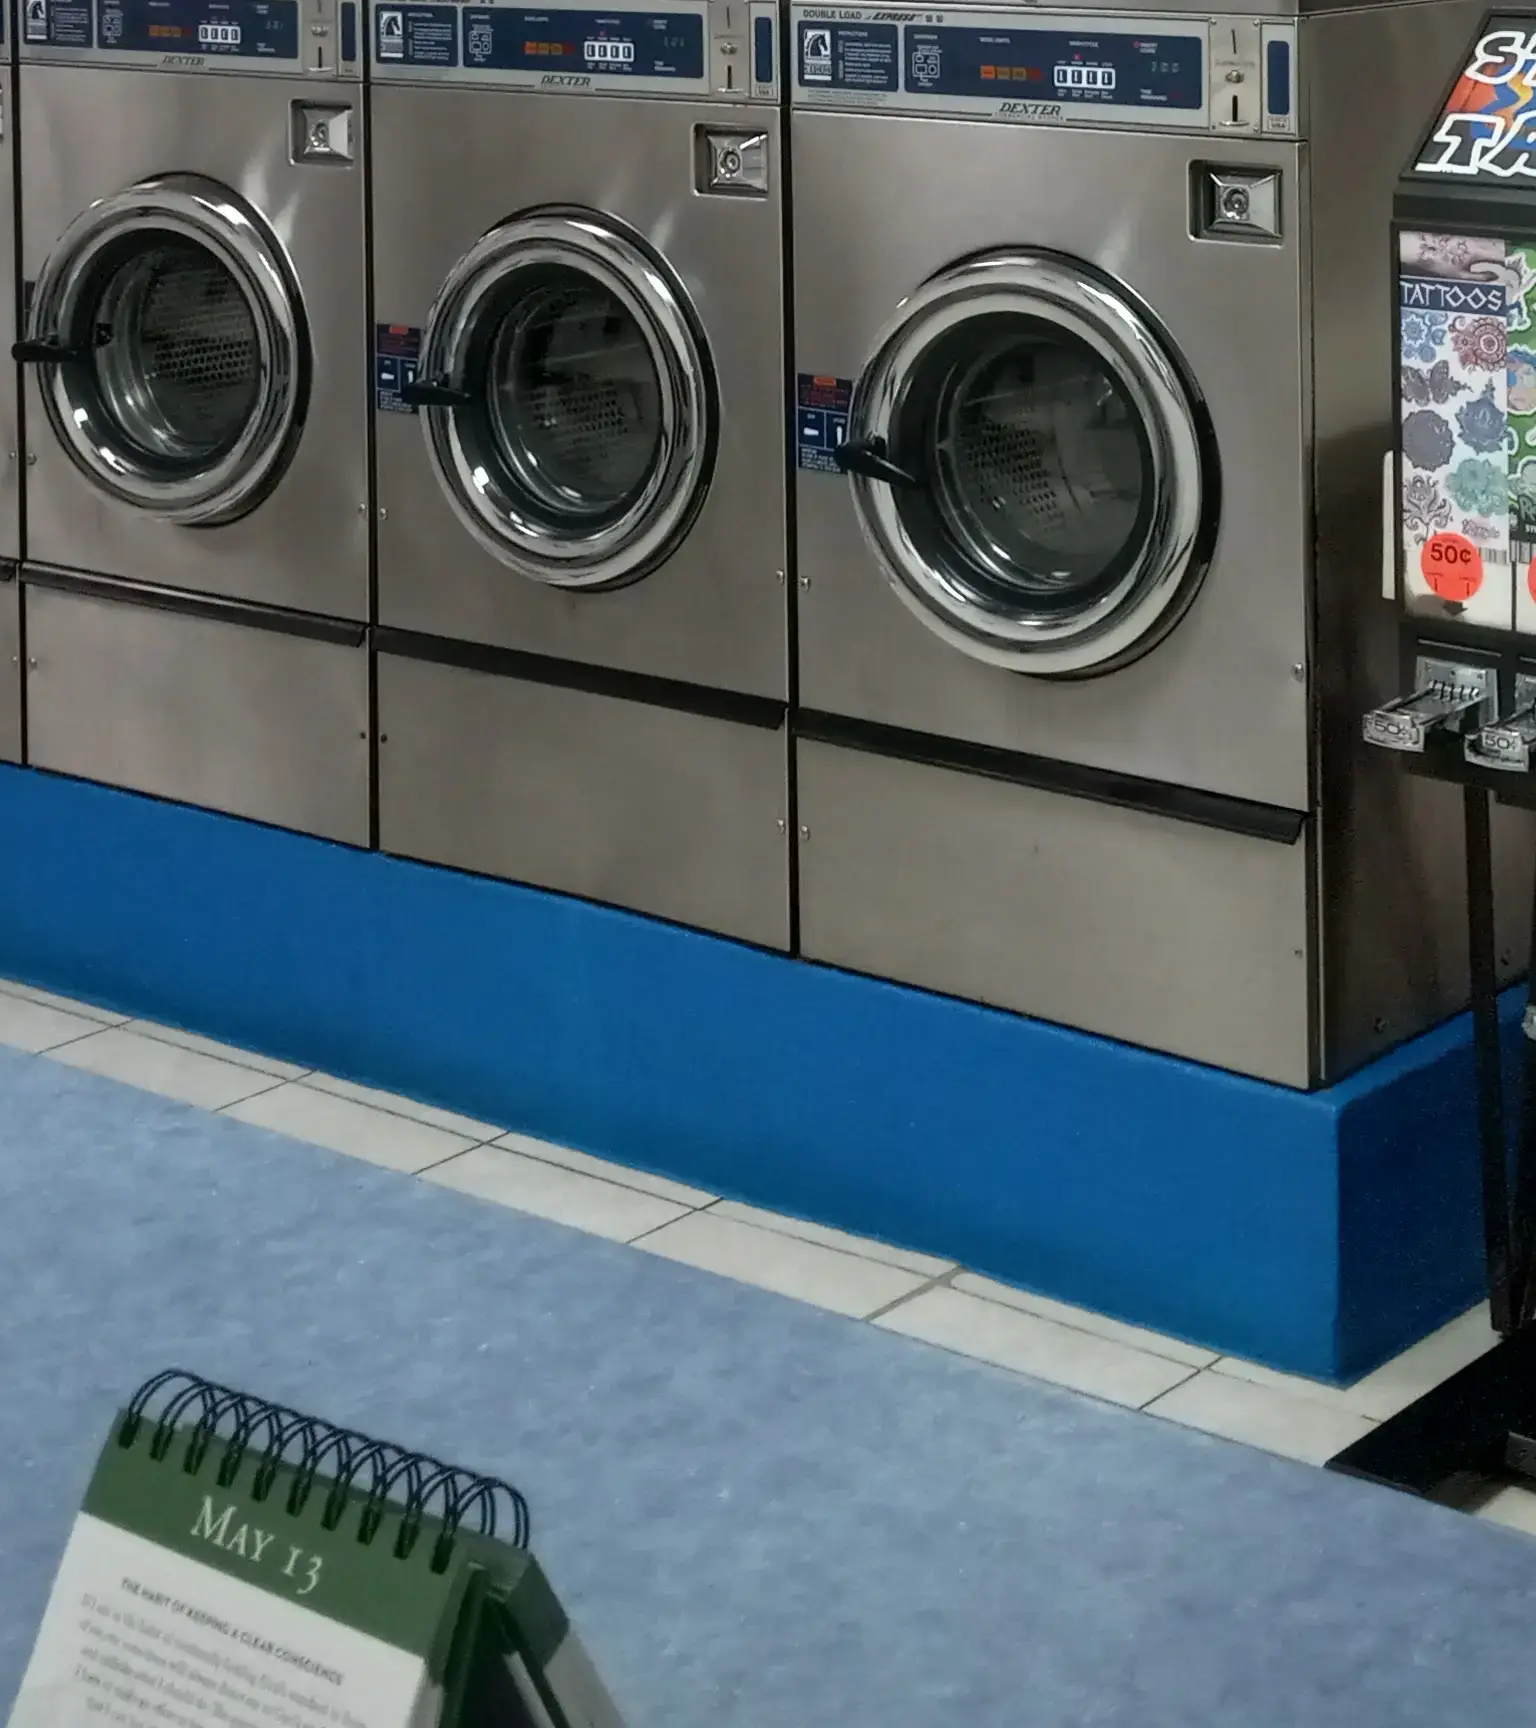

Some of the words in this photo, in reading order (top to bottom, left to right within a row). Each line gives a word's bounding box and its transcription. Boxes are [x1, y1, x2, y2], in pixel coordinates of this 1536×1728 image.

[803, 9, 837, 19] DOUBLE
[838, 10, 862, 20] LOAD
[163, 54, 205, 66] DEXTER
[540, 75, 591, 88] DEXTER
[999, 101, 1062, 116] DEXTER
[1400, 280, 1503, 312] TATTOOS
[1430, 543, 1472, 566] 50¢
[190, 1495, 275, 1562] MAY
[281, 1542, 323, 1595] 13
[239, 1630, 274, 1654] CLEAR
